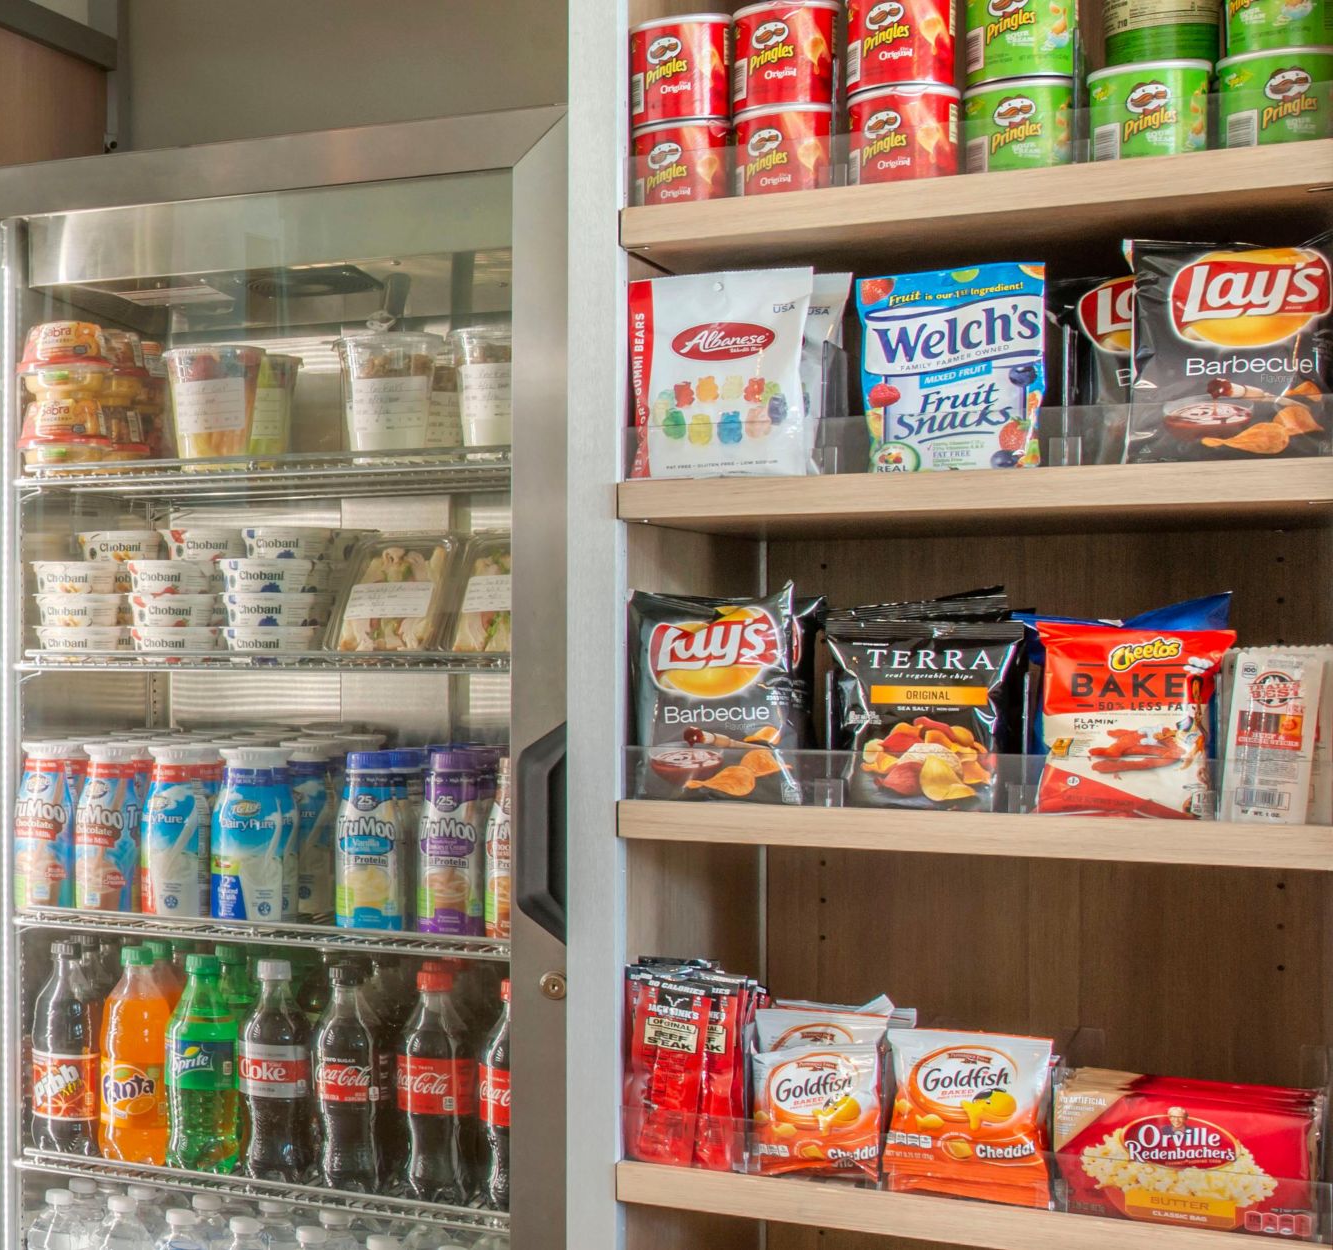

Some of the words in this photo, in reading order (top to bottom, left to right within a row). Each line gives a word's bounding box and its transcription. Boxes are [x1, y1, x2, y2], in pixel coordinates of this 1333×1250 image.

[986, 11, 1036, 46] Pringles
[863, 24, 910, 56] Pringles
[749, 43, 794, 74] Pringles
[878, 48, 913, 61] Original
[645, 58, 688, 89] Pringles
[764, 67, 797, 80] Original
[660, 83, 691, 94] Original
[1262, 96, 1317, 129] Pringles
[1124, 107, 1177, 142] Pringles
[991, 122, 1042, 154] Pringles
[660, 187, 691, 199] Original
[888, 291, 921, 306] Fruit
[970, 281, 1024, 297] Ingredient!
[1181, 262, 1324, 323] Lay's
[773, 304, 795, 313] USA
[635, 313, 646, 353] BEARS
[680, 330, 767, 353] Albanese
[873, 304, 1040, 364] Welch's
[900, 363, 931, 371] FAMILY
[937, 353, 971, 366] FARMER
[975, 345, 1009, 356] OWNED
[1186, 355, 1315, 376] Barbecue
[635, 356, 643, 395] GUMMI
[924, 373, 956, 384] MIXED
[959, 364, 988, 377] FRUIT
[920, 383, 999, 414] Fruit
[894, 404, 1013, 440] Snacks
[876, 465, 908, 473] REAL
[186, 540, 228, 553] Chobani
[256, 538, 300, 551] Chobani
[46, 572, 89, 586] Chobani
[139, 571, 182, 584] Chobani
[239, 569, 285, 583] Chobani
[143, 637, 185, 651] Chobani
[657, 618, 770, 671] Lay's
[1109, 638, 1182, 671] Cheetos
[867, 649, 996, 670] TERRA
[885, 672, 902, 680] real
[904, 672, 948, 681] vegetable
[950, 673, 974, 681] chips
[1070, 673, 1187, 698] BAKE
[905, 690, 950, 701] ORIGINAL
[1098, 701, 1125, 711] 50%
[1130, 701, 1162, 711] LESS
[664, 704, 769, 725] Barbecue
[337, 817, 395, 840] TruMoo
[421, 818, 476, 841] TruMoo
[354, 856, 386, 864] Protein
[434, 858, 466, 867] Protein
[661, 982, 705, 996] CALORIES
[648, 1004, 668, 1014] JACK
[655, 1031, 688, 1041] BEEF
[173, 1054, 210, 1073] Sprite
[240, 1059, 286, 1081] Coke
[315, 1064, 372, 1087] Coca-Cola
[923, 1066, 1011, 1092] Goldfish
[103, 1070, 154, 1103] Fanta
[776, 1072, 852, 1102] Goldfish
[793, 1096, 825, 1105] BAKED
[1068, 1096, 1107, 1106] ARTIFICIAL
[1138, 1124, 1222, 1148] Orville
[1124, 1141, 1235, 1163] Redenbacher's
[1150, 1196, 1209, 1211] BUTTER
[1152, 1210, 1191, 1222] CLASSIC
[1192, 1214, 1208, 1222] BAG
